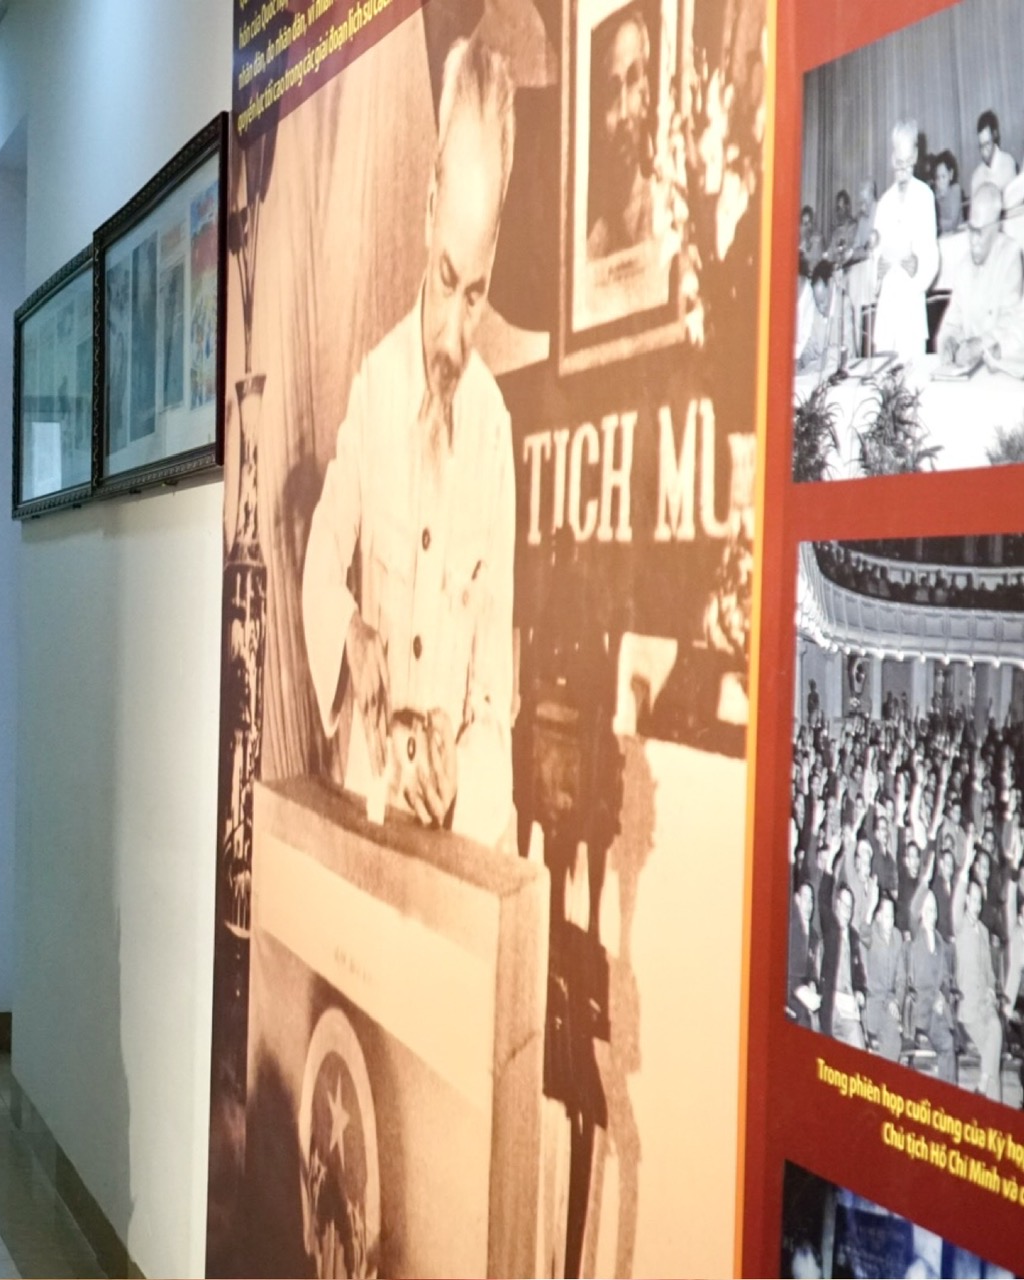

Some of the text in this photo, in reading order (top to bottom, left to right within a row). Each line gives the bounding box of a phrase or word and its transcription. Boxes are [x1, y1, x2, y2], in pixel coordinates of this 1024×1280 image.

[275, 26, 292, 56] nhân
[328, 25, 348, 54] đoạn
[816, 1057, 848, 1096] Trong
[848, 1071, 881, 1105] phiên
[881, 1082, 905, 1118] họp
[905, 1097, 932, 1125] cuối
[932, 1106, 963, 1145] cùng
[963, 1116, 986, 1149] của
[881, 1121, 905, 1151] Chủ
[905, 1130, 929, 1161] tịch
[929, 1140, 948, 1171] Hồ
[947, 1150, 969, 1179] Chí
[968, 1157, 1001, 1195] Minh
[1001, 1174, 1019, 1203] và
